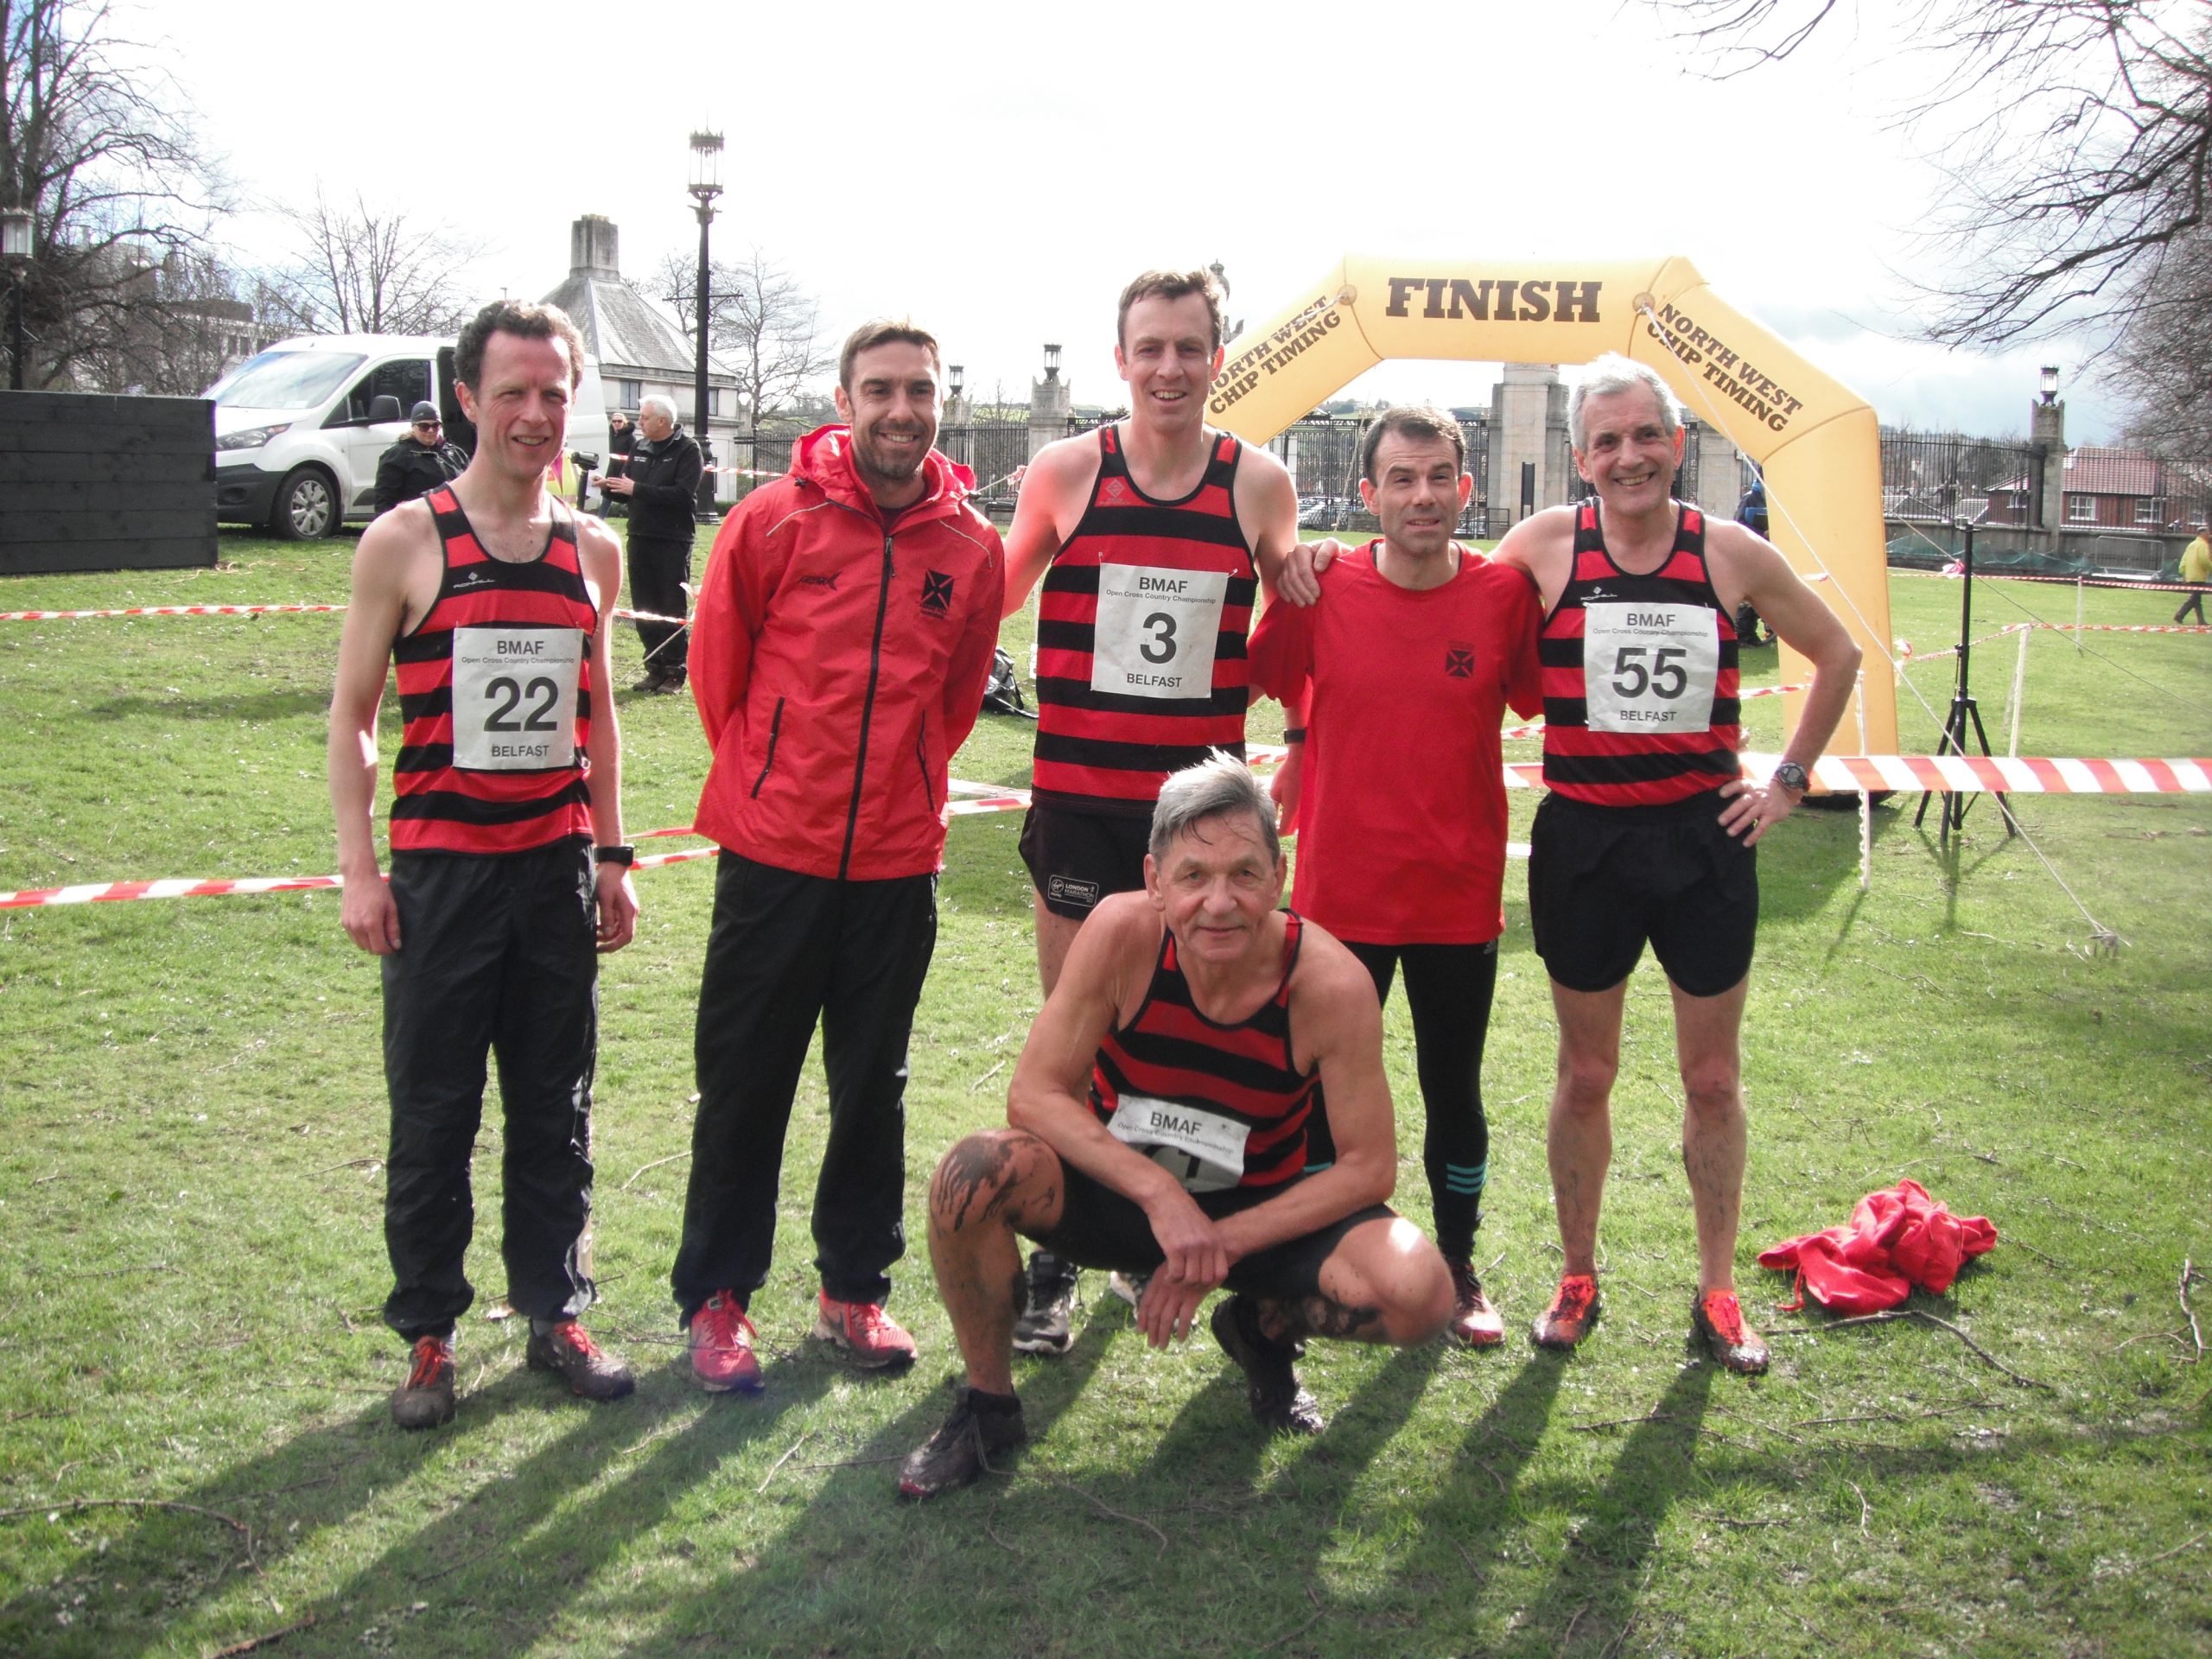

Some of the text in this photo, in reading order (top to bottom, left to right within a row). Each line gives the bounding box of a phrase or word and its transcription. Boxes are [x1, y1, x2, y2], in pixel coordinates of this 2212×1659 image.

[1386, 277, 1603, 322] FINISH
[1271, 296, 1327, 345] WEST
[1210, 310, 1340, 414] CHIP TIMING
[1657, 303, 1803, 416] NORTH WEST
[1647, 321, 1789, 431] CHIP TIMING
[1139, 576, 1188, 594] BMAF
[1145, 593, 1171, 601] Country
[1173, 594, 1217, 604] Championship
[1627, 613, 1676, 627] BMAF
[497, 640, 544, 655] BMAF
[1140, 612, 1177, 664] 3
[1127, 673, 1182, 688] BELFAST
[1612, 647, 1688, 700] 55
[483, 677, 558, 732] 22
[1620, 710, 1676, 722] BELFAST
[492, 746, 550, 758] BELFAST
[1065, 883, 1089, 893] LONDON
[1065, 888, 1095, 899] MARATHON
[1150, 1111, 1203, 1136] BMAF
